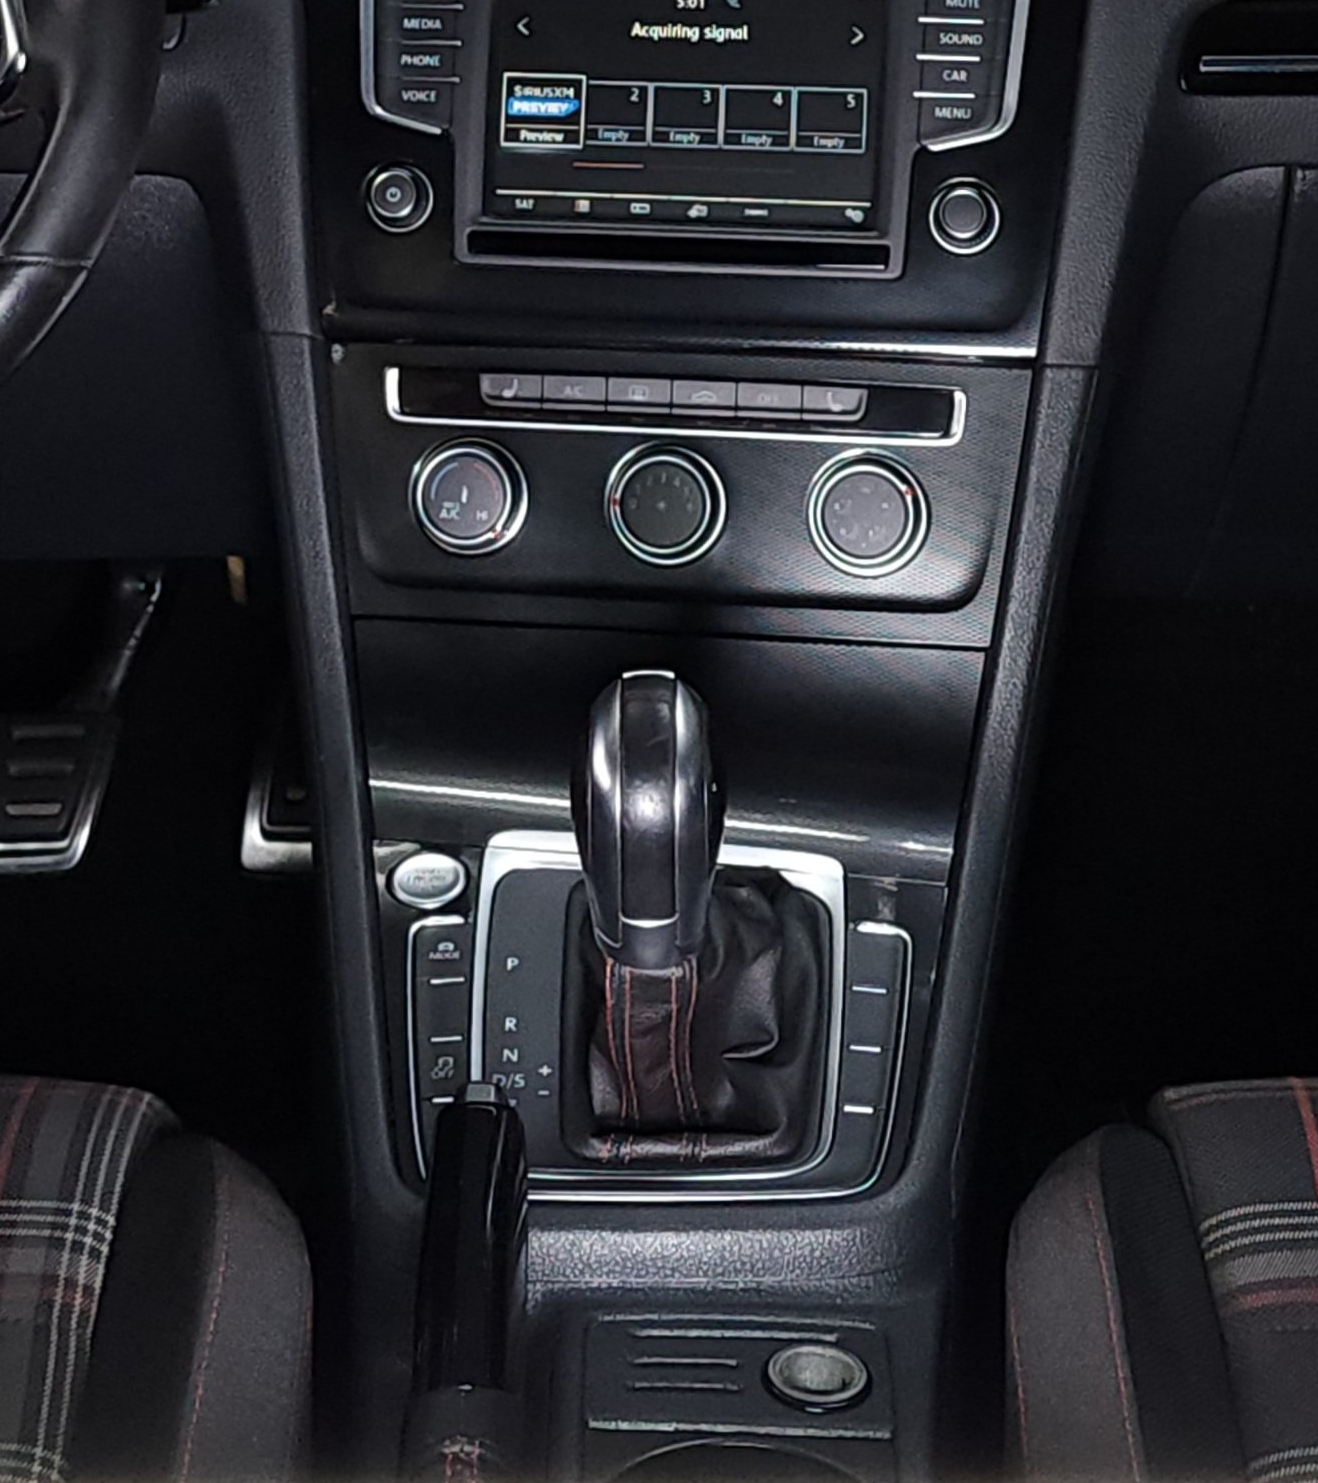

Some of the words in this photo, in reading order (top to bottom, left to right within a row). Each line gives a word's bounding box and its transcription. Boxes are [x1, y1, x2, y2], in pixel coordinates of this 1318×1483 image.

[403, 17, 442, 32] MEDIA
[630, 22, 699, 42] Acquiring
[703, 23, 748, 42] signal
[938, 31, 983, 47] SOUND
[400, 53, 441, 68] PHONE
[942, 68, 968, 83] CAR
[400, 88, 437, 103] VOICE
[629, 87, 640, 102] 2
[701, 89, 712, 104] 3
[771, 91, 784, 106] 4
[846, 93, 857, 108] 5
[934, 105, 972, 121] MENU
[519, 129, 565, 143] Preview
[597, 128, 630, 142] Empty
[669, 131, 701, 145] Empty
[741, 133, 773, 147] Empty
[813, 135, 845, 149] Empty
[514, 198, 535, 210] SAT
[428, 951, 460, 960] MODE
[505, 956, 520, 972] P
[504, 1016, 518, 1032] R
[502, 1047, 519, 1063] N
[492, 1073, 526, 1089] D/S
